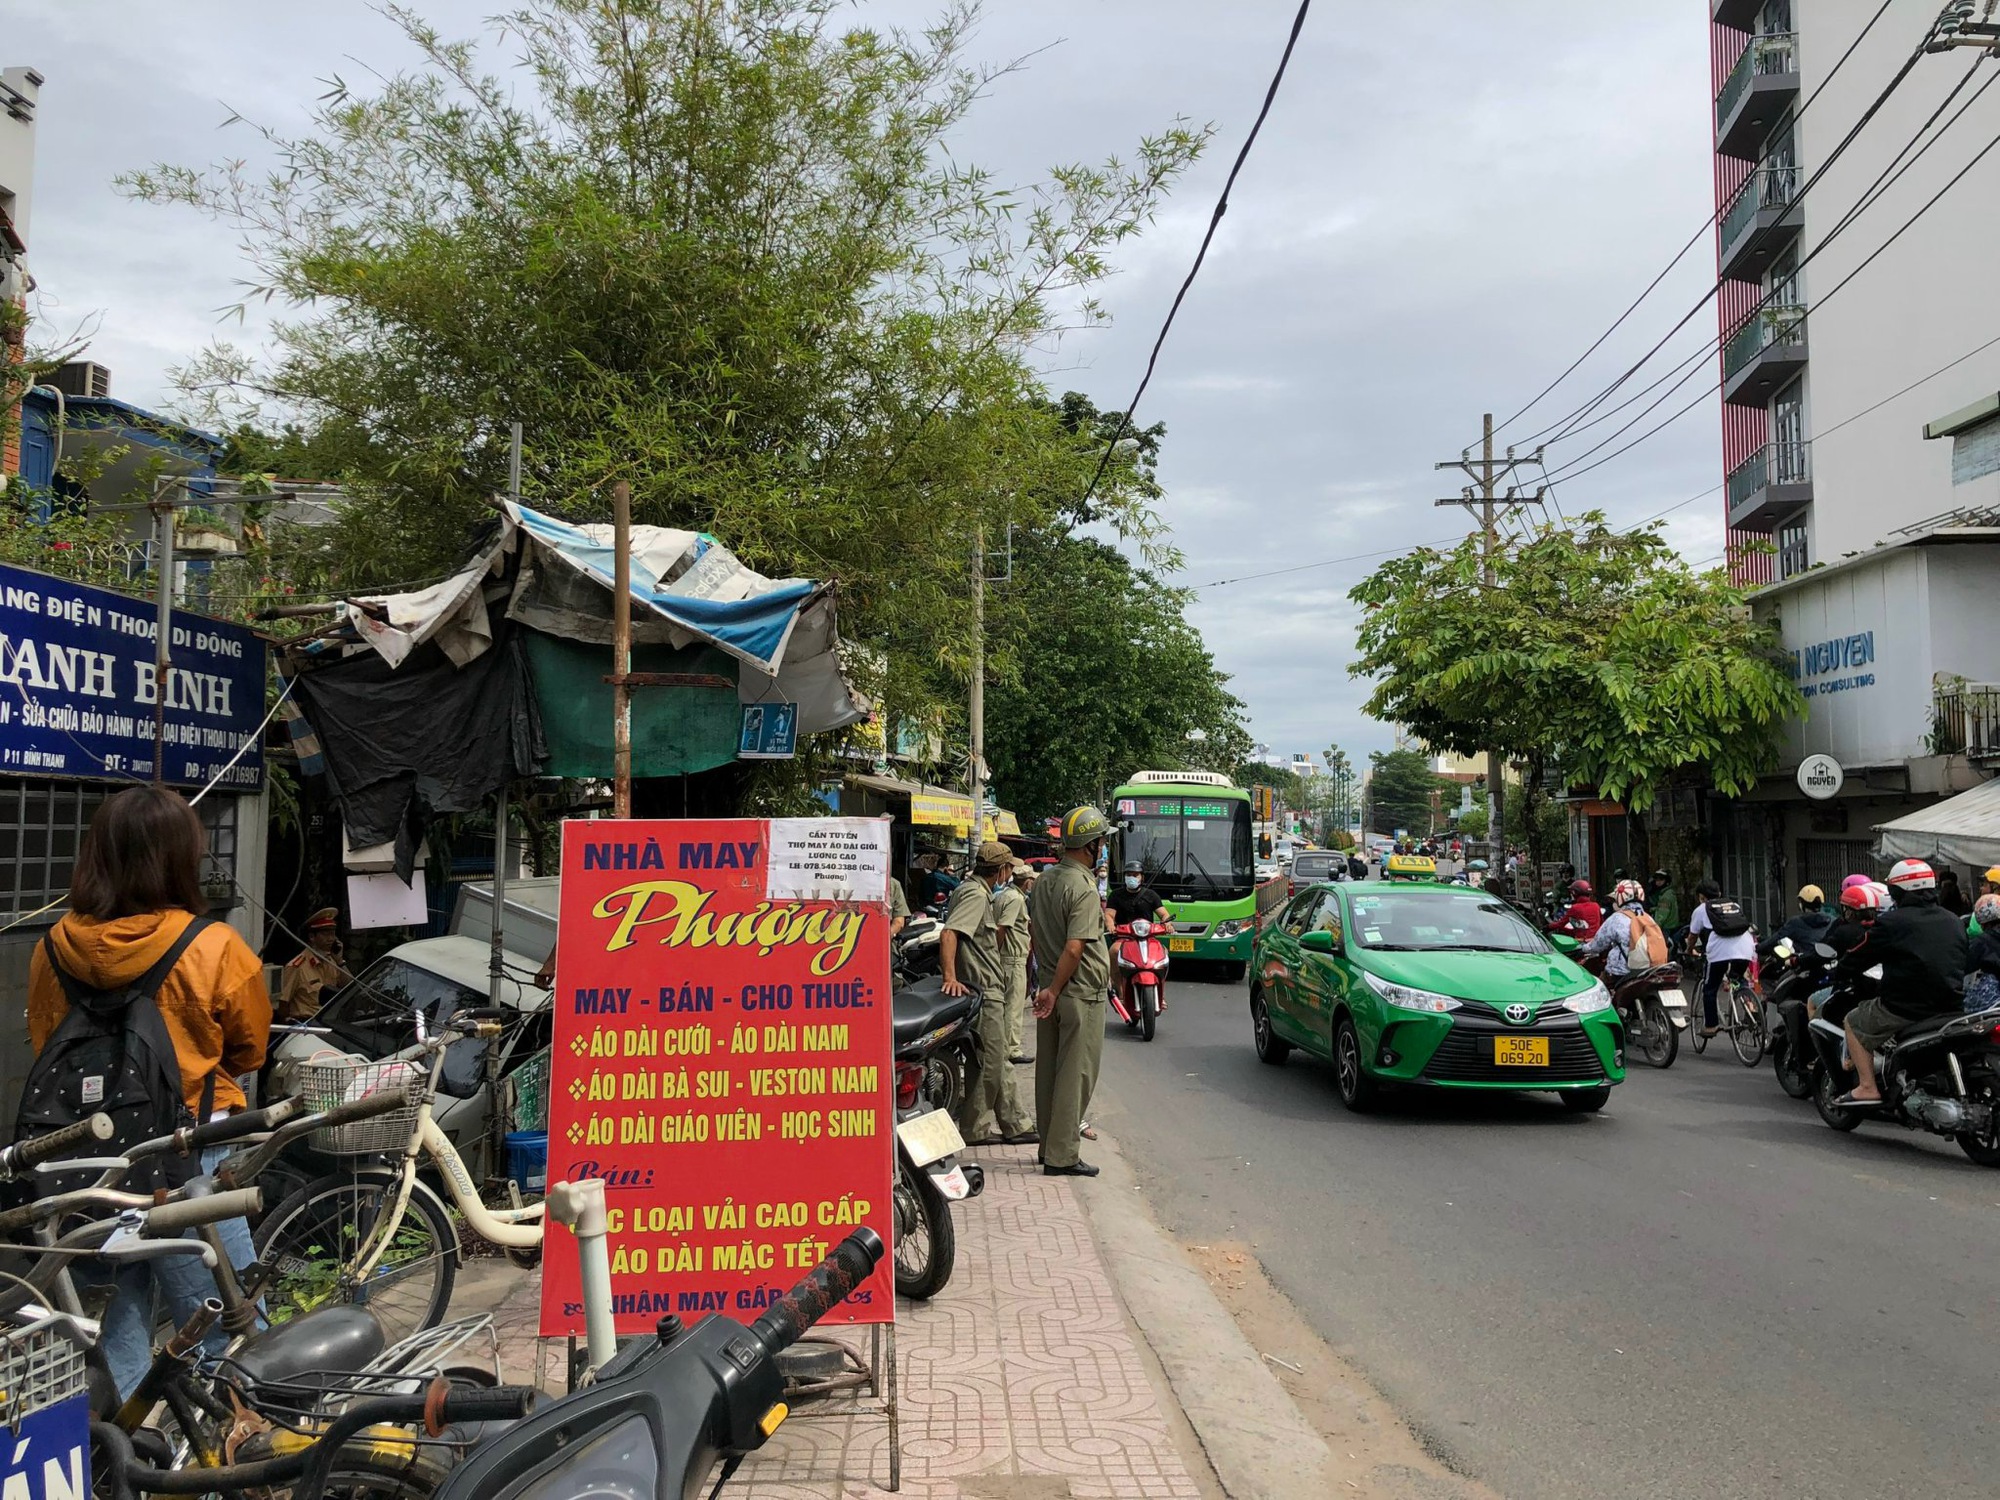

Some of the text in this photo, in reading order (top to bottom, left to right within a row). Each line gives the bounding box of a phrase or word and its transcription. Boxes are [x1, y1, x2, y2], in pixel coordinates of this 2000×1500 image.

[47, 597, 102, 627] ĐIỆN
[108, 610, 158, 644] THOẠ
[173, 627, 191, 647] DI
[196, 632, 242, 658] ĐỘNG
[1805, 631, 1875, 676] NGUYEN
[22, 696, 46, 728] SỬA
[49, 703, 79, 731] CHỮA
[81, 705, 104, 734] BẢO
[106, 710, 133, 737] HÀNH
[137, 715, 156, 740] CÁC
[161, 723, 179, 747] OẠI
[180, 722, 201, 750] ĐIỆN
[203, 727, 226, 753] THOẠI
[228, 732, 237, 749] DI
[4, 748, 10, 763] P
[12, 750, 20, 764] 11
[42, 752, 65, 772] THẠNH
[1121, 801, 1132, 813] 31
[583, 837, 759, 870] NHÀ MAY
[1397, 857, 1430, 866] TAXI
[208, 872, 226, 885] 251
[592, 879, 868, 976] Phượng
[574, 987, 632, 1014] MAY
[659, 981, 714, 1013] BÁN
[741, 984, 793, 1011] CHO
[801, 977, 874, 1009] THUÊ:
[589, 1023, 617, 1057] ÁO
[624, 1023, 658, 1057] DÀI
[664, 1022, 711, 1056] CƯỚI
[730, 1021, 757, 1054] ÁO
[763, 1020, 797, 1052] DÀI
[803, 1024, 849, 1051] NAM
[1510, 1039, 1533, 1051] 50E
[1501, 1052, 1543, 1064] 069.20
[587, 1068, 616, 1101] ÁO
[622, 1067, 656, 1100] DÀI
[662, 1066, 690, 1099] BÀ
[695, 1070, 730, 1098] SUI
[750, 1067, 825, 1096] VESTON
[831, 1066, 879, 1094] NAM
[585, 1112, 614, 1145] ÁO
[620, 1111, 655, 1144] DÀI
[661, 1109, 709, 1144] GIÁO
[715, 1107, 761, 1141] VIÊN
[781, 1110, 822, 1145] HỌC
[828, 1109, 876, 1137] SINH
[633, 1206, 694, 1237] LOẠI
[703, 1197, 746, 1230] VẢI
[755, 1202, 808, 1229] CAO
[817, 1191, 871, 1226] CẤP
[611, 1234, 829, 1275] ÁO DÀI MẶC TẾT
[678, 1291, 728, 1312] MAY
